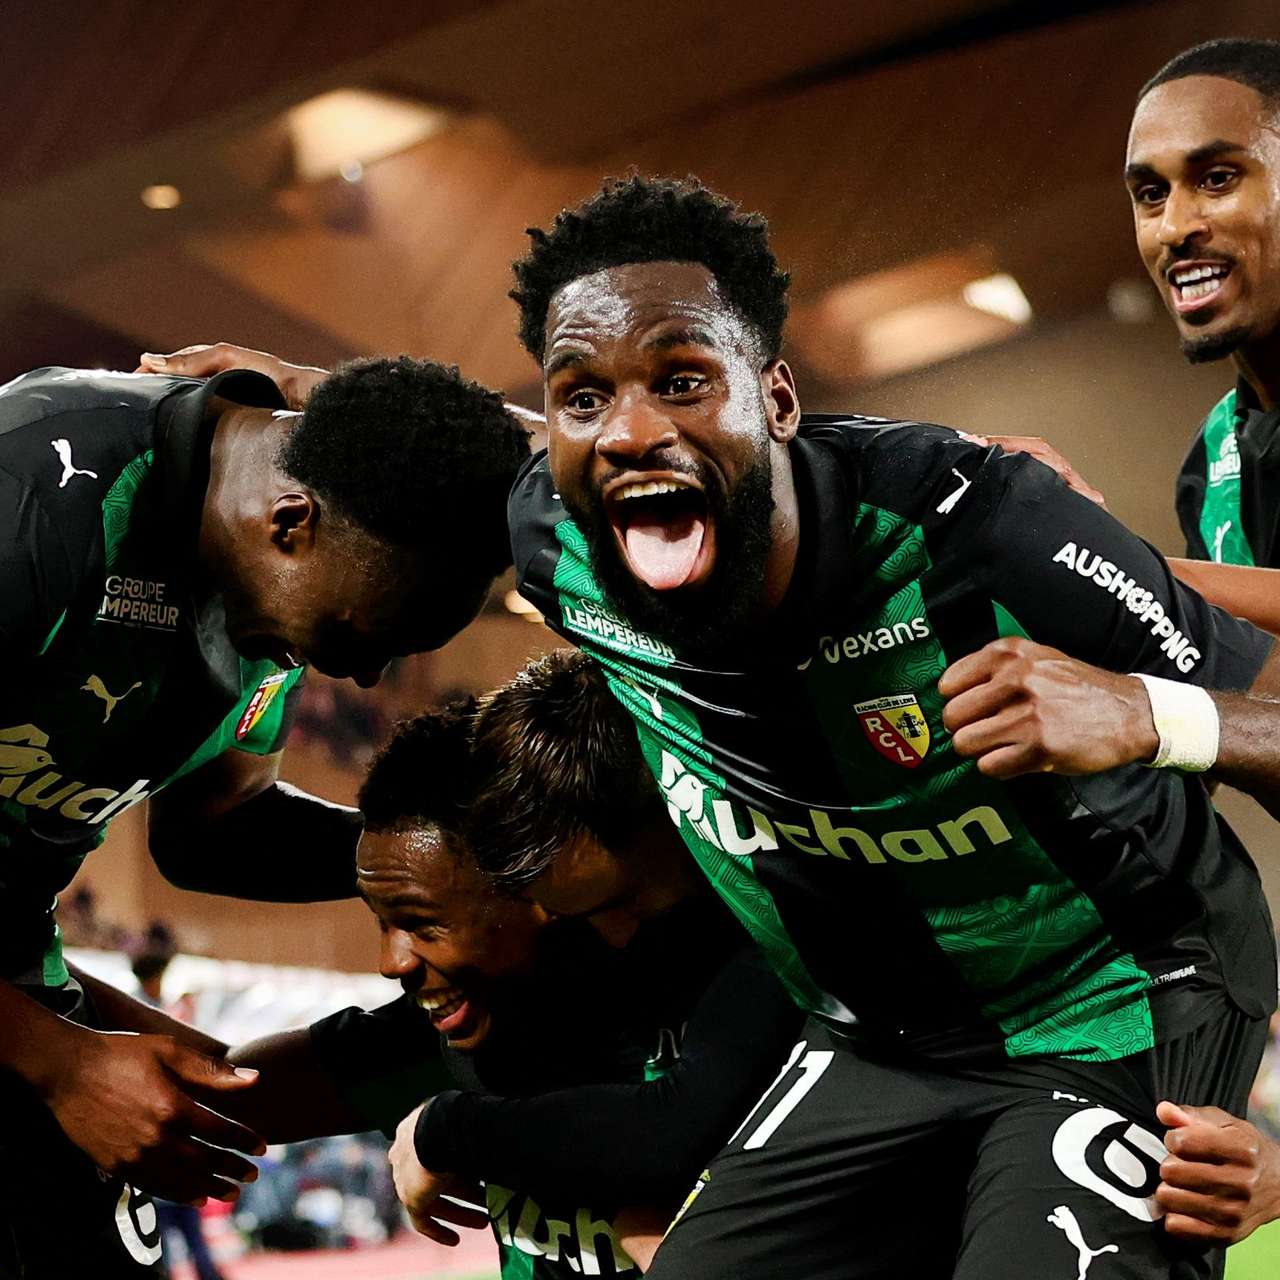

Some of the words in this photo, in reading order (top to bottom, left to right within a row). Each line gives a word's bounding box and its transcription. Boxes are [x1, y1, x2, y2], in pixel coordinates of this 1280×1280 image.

[564, 605, 677, 660] LEMPEREUR
[1052, 541, 1201, 674] AUSHOPPNG
[865, 716, 915, 763] RCL
